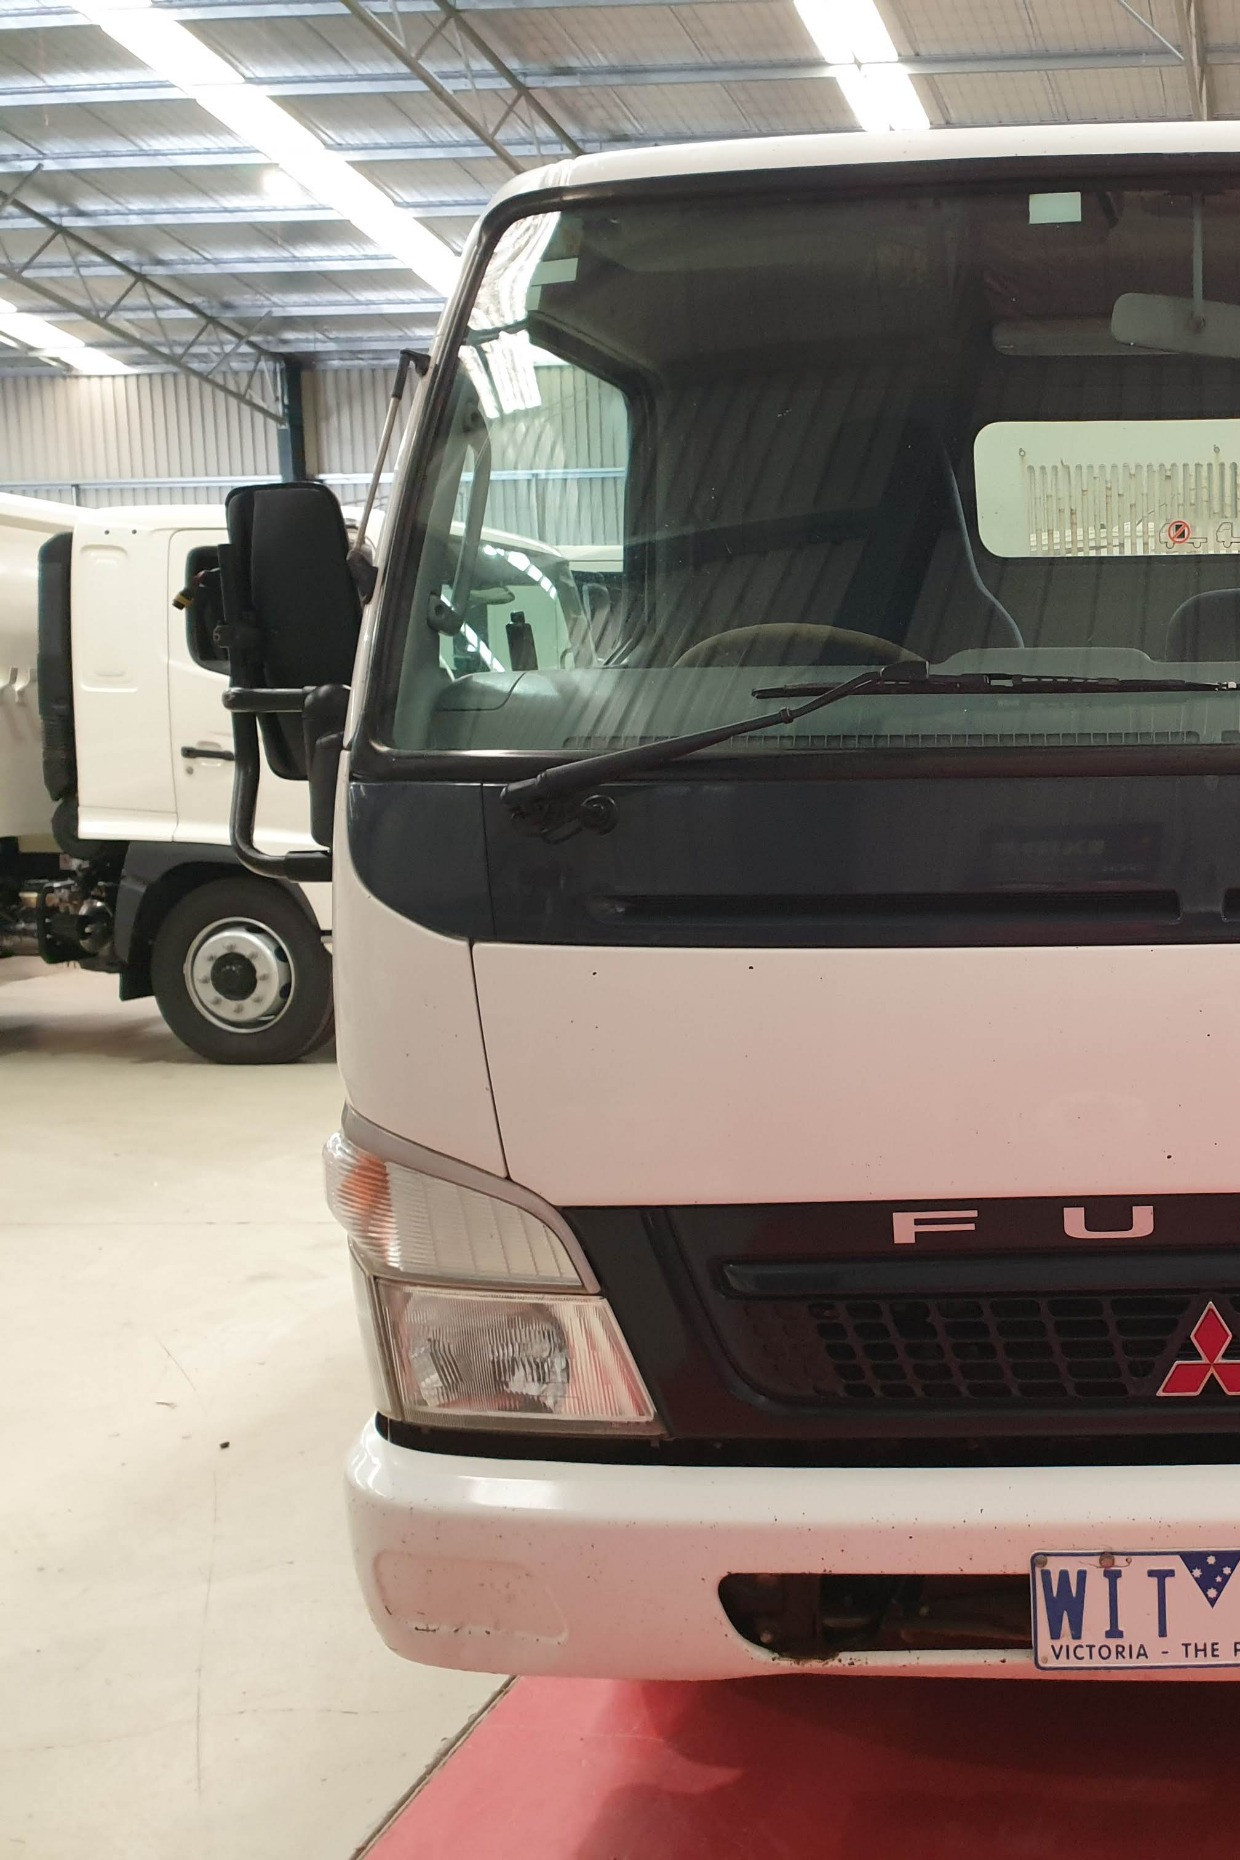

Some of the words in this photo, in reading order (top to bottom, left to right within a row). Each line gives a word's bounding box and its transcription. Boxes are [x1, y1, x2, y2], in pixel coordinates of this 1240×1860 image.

[1041, 1568, 1175, 1640] WIT
[1051, 1643, 1149, 1660] VICTORIA
[1181, 1642, 1220, 1658] THE
